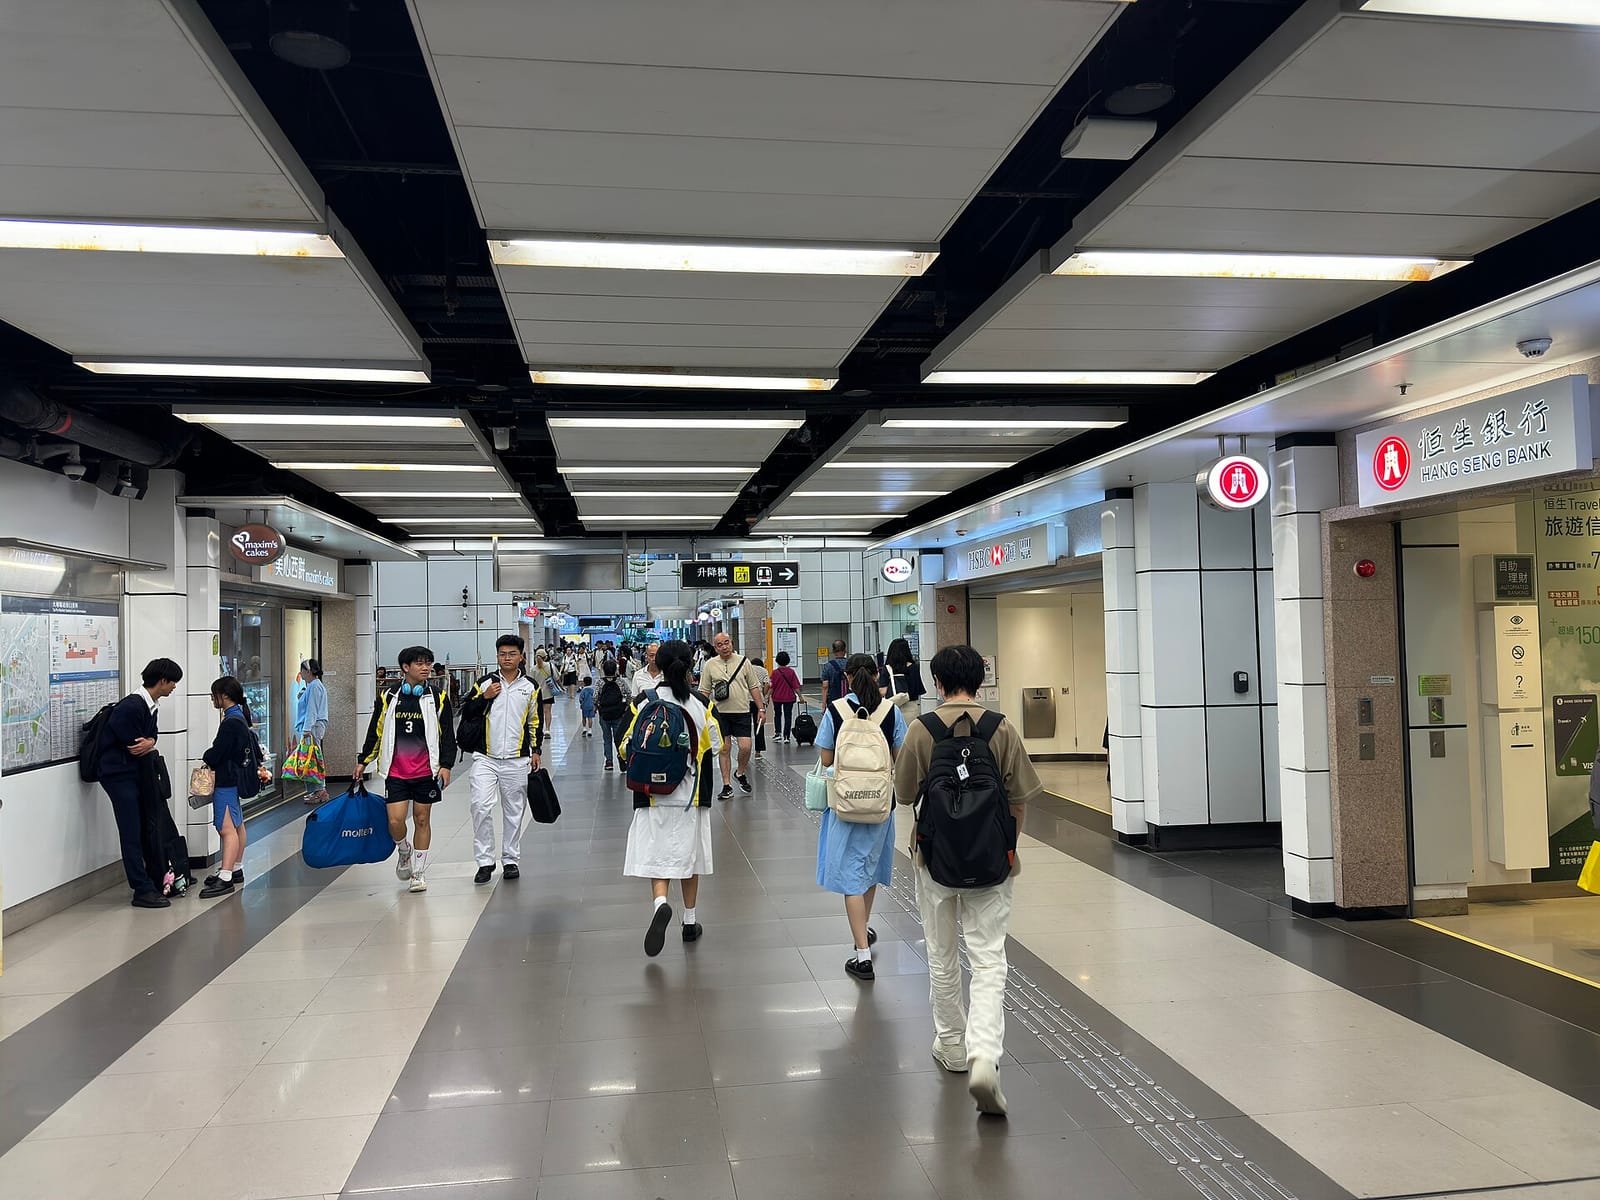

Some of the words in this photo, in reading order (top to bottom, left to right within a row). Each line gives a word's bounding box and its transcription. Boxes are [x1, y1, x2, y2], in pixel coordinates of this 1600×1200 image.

[1418, 398, 1550, 461] 恒生銀行
[1420, 460, 1458, 483] HANG
[1463, 452, 1502, 474] SENG
[1507, 440, 1553, 466] BANK
[244, 540, 278, 549] maxim's
[245, 548, 269, 557] cakes
[967, 546, 991, 571] HSBC
[696, 566, 728, 578] 升降機
[1499, 560, 1518, 572] 自助
[305, 568, 322, 585] maxim's
[322, 571, 334, 587] cakes
[1508, 572, 1528, 583] 理財
[405, 721, 413, 733] 3
[844, 789, 882, 800] SKECHERS
[341, 827, 373, 838] molten
